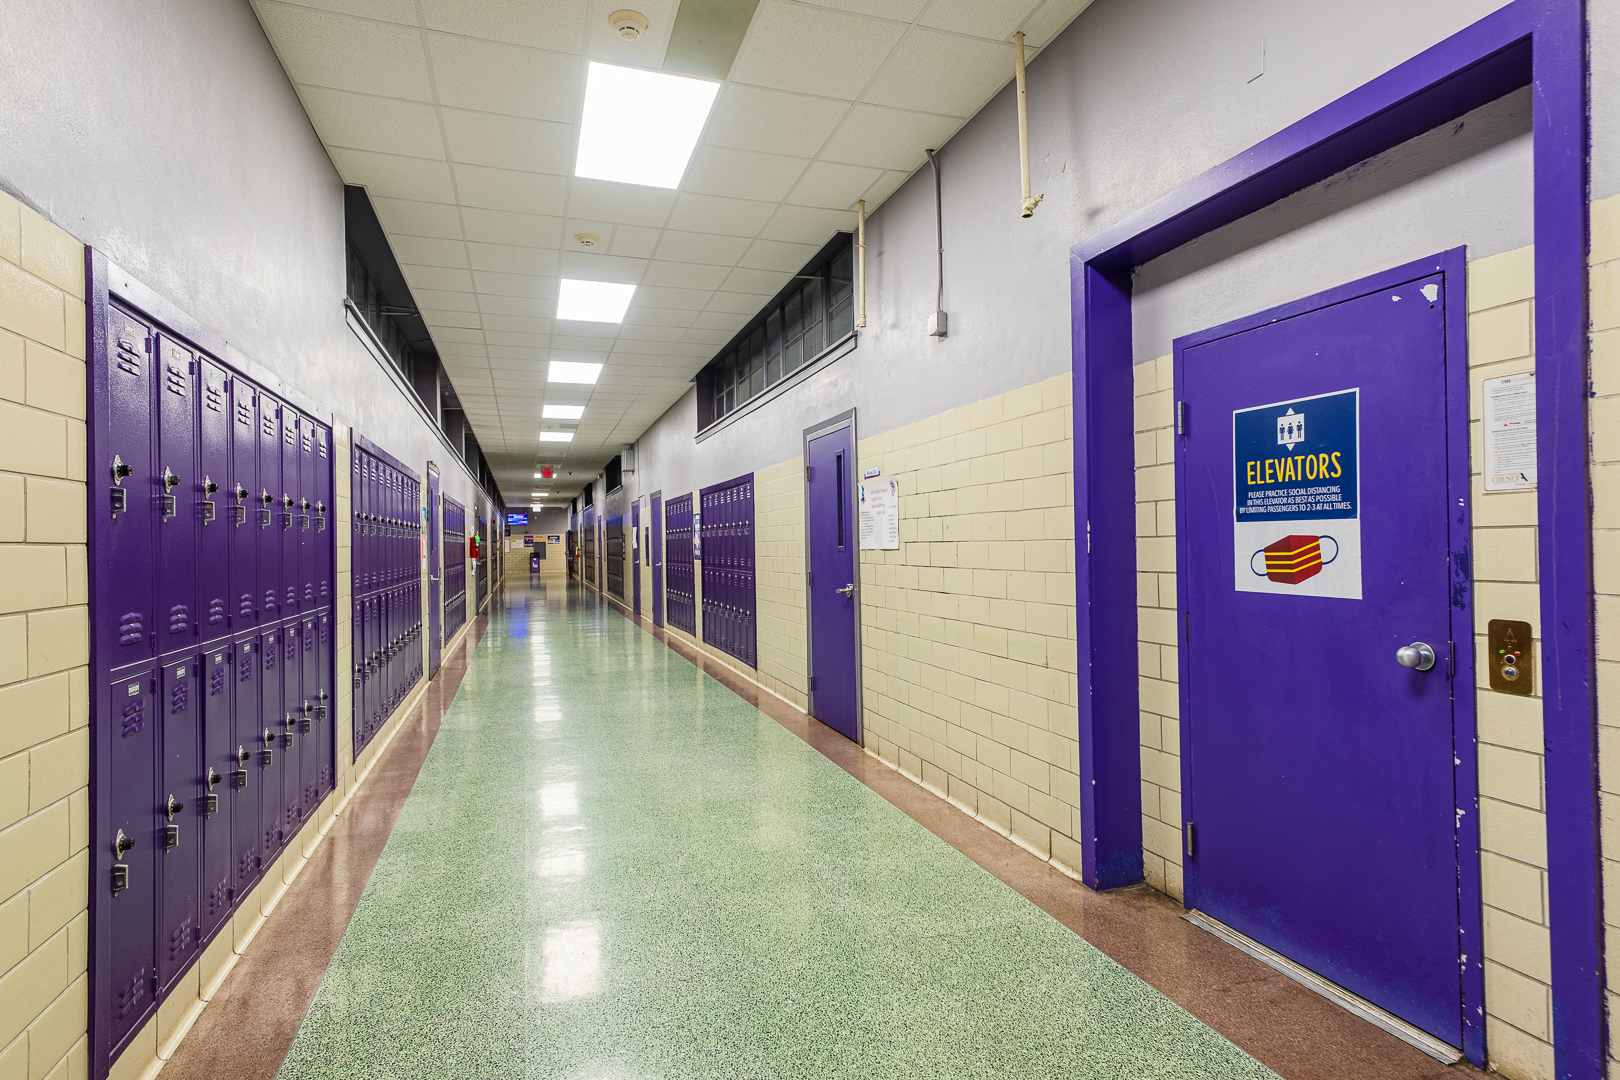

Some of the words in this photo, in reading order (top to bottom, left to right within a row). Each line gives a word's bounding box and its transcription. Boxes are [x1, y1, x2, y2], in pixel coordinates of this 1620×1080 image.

[1247, 451, 1342, 485] ELEVATORS
[1248, 490, 1265, 499] PLEASE
[1265, 489, 1288, 498] PRACTICE
[1288, 487, 1307, 496] SOCIAL
[1307, 485, 1341, 495] DISTANCING
[1252, 498, 1264, 506] THIS
[1264, 496, 1287, 505] ELEVATOR
[1287, 496, 1295, 504] AS
[1295, 495, 1308, 503] BEST
[1307, 495, 1316, 503] AS
[1316, 493, 1343, 502] POSSIBLE
[1245, 505, 1267, 514] LIMITING
[1267, 504, 1299, 513] PASSENGERS
[1306, 503, 1316, 511] 2-3
[1316, 502, 1324, 510] AT
[1323, 502, 1334, 510] ALL
[1333, 501, 1353, 510] TIMES.
